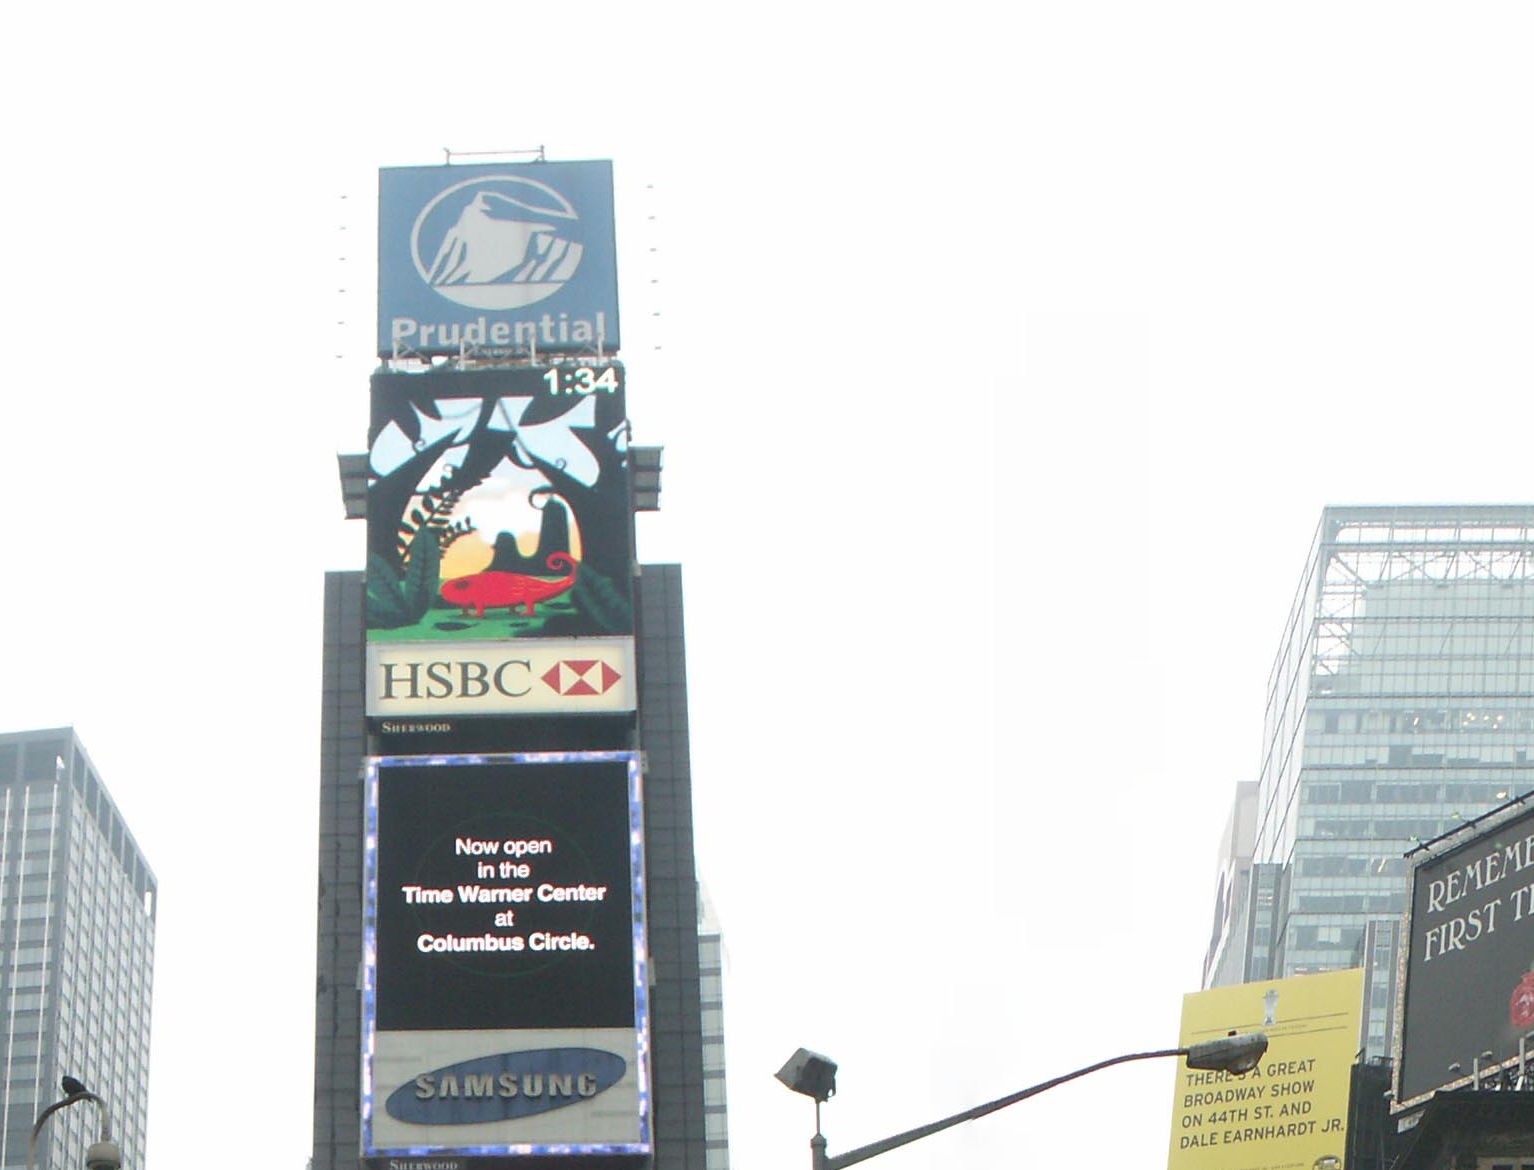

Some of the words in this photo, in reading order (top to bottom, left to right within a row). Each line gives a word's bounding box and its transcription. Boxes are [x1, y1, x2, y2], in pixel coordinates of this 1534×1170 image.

[392, 312, 606, 347] Prudential
[543, 367, 619, 396] 1:34
[379, 659, 533, 700] HSBC
[455, 838, 500, 857] Now
[503, 838, 552, 861] open
[477, 862, 495, 878] in
[499, 862, 530, 878] the
[401, 885, 454, 905] Time
[457, 884, 532, 904] Warner
[536, 883, 606, 902] Center
[494, 910, 514, 928] at
[1423, 900, 1505, 963] FIRST
[417, 933, 525, 953] Columbus
[528, 932, 596, 952] Circle.
[414, 1071, 599, 1100] SAMSUNG
[1184, 1085, 1266, 1108] BROADWAY
[1270, 1079, 1315, 1098] SHOW
[1181, 1114, 1203, 1129] ON
[1208, 1110, 1248, 1126] 44TH
[1253, 1105, 1274, 1120] ST.
[1279, 1100, 1312, 1117] AND
[1180, 1132, 1218, 1150] DALE
[1223, 1120, 1316, 1144] EARNHARDT
[1321, 1118, 1345, 1133] JR.
